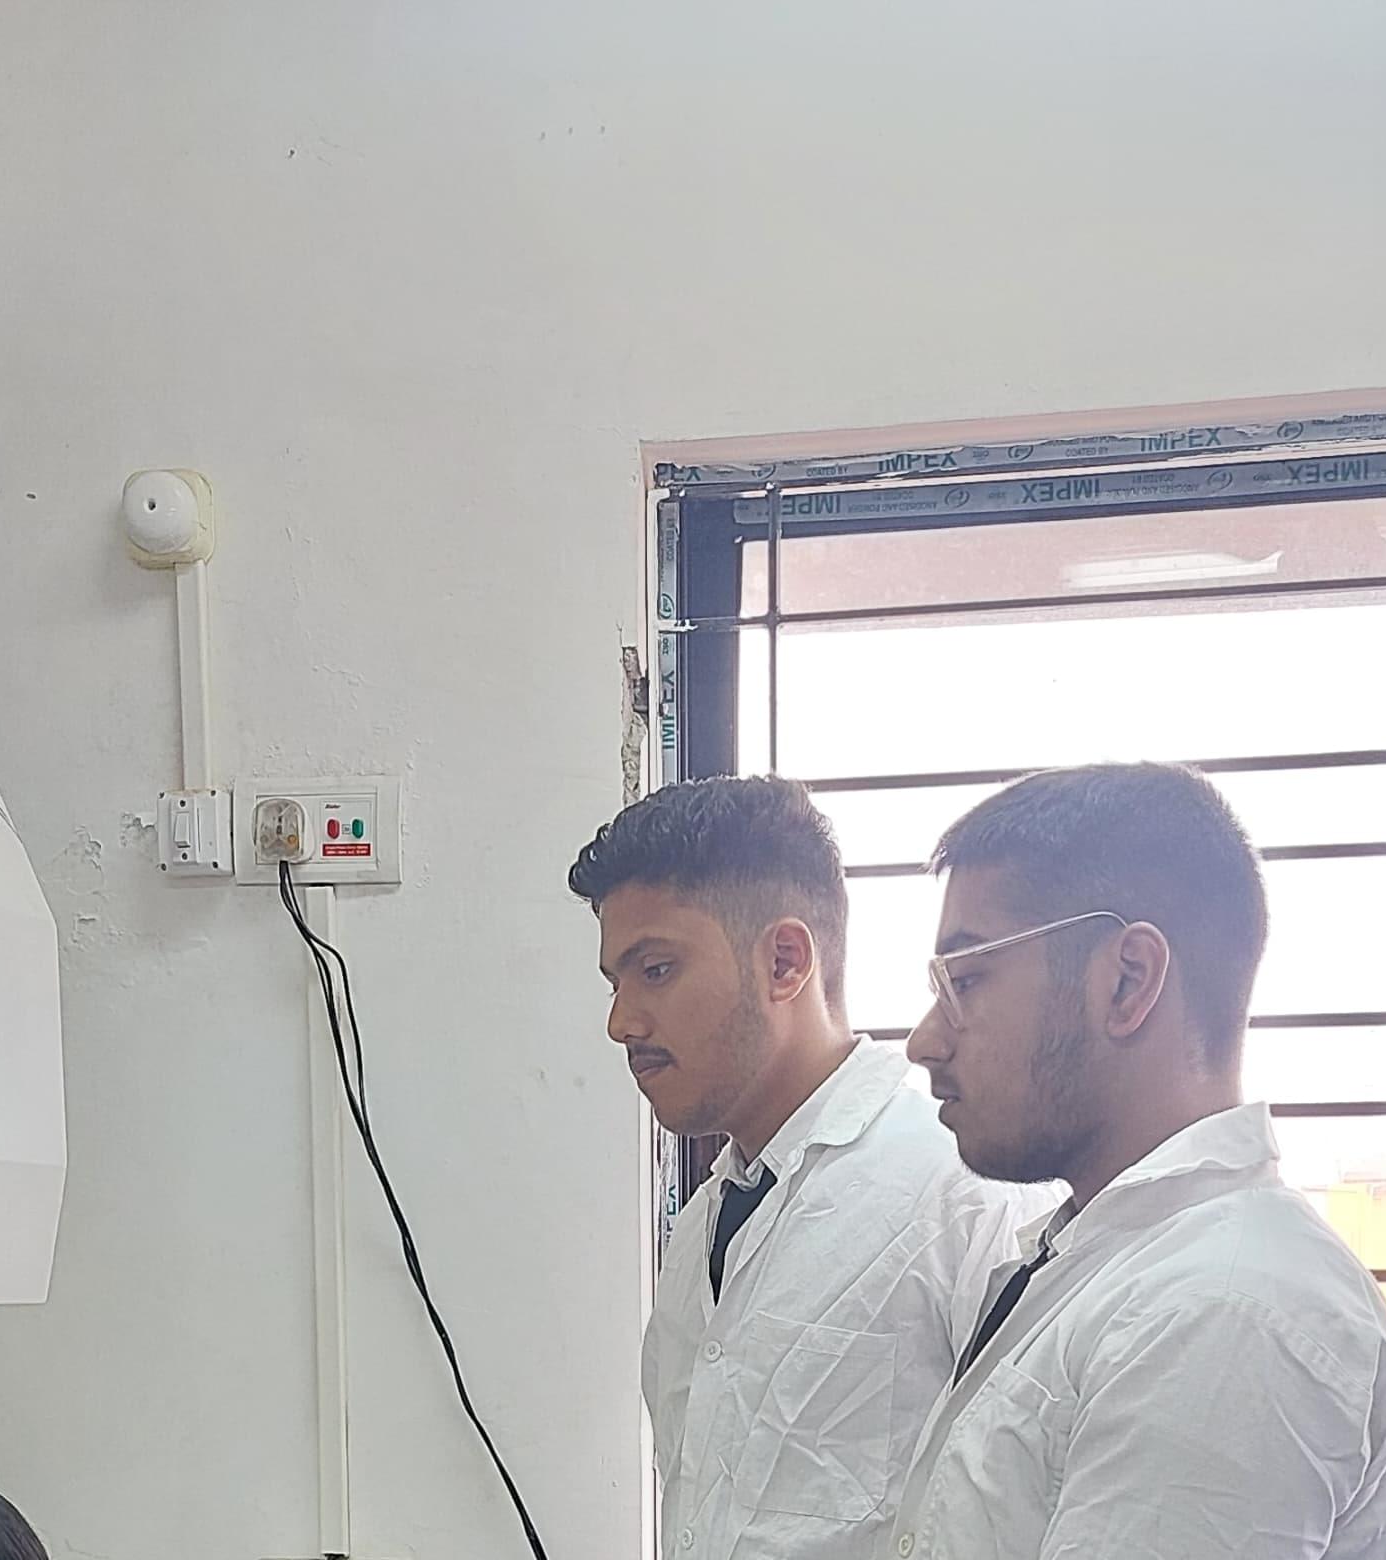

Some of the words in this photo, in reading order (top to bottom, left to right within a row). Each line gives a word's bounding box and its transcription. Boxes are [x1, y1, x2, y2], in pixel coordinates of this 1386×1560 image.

[1140, 427, 1222, 452] IMPEX
[877, 451, 958, 473] IMPEX
[1065, 446, 1097, 458] COATED
[1286, 460, 1369, 485] IMPEX
[1020, 478, 1100, 504] IMPEX
[781, 494, 843, 516] IMPE
